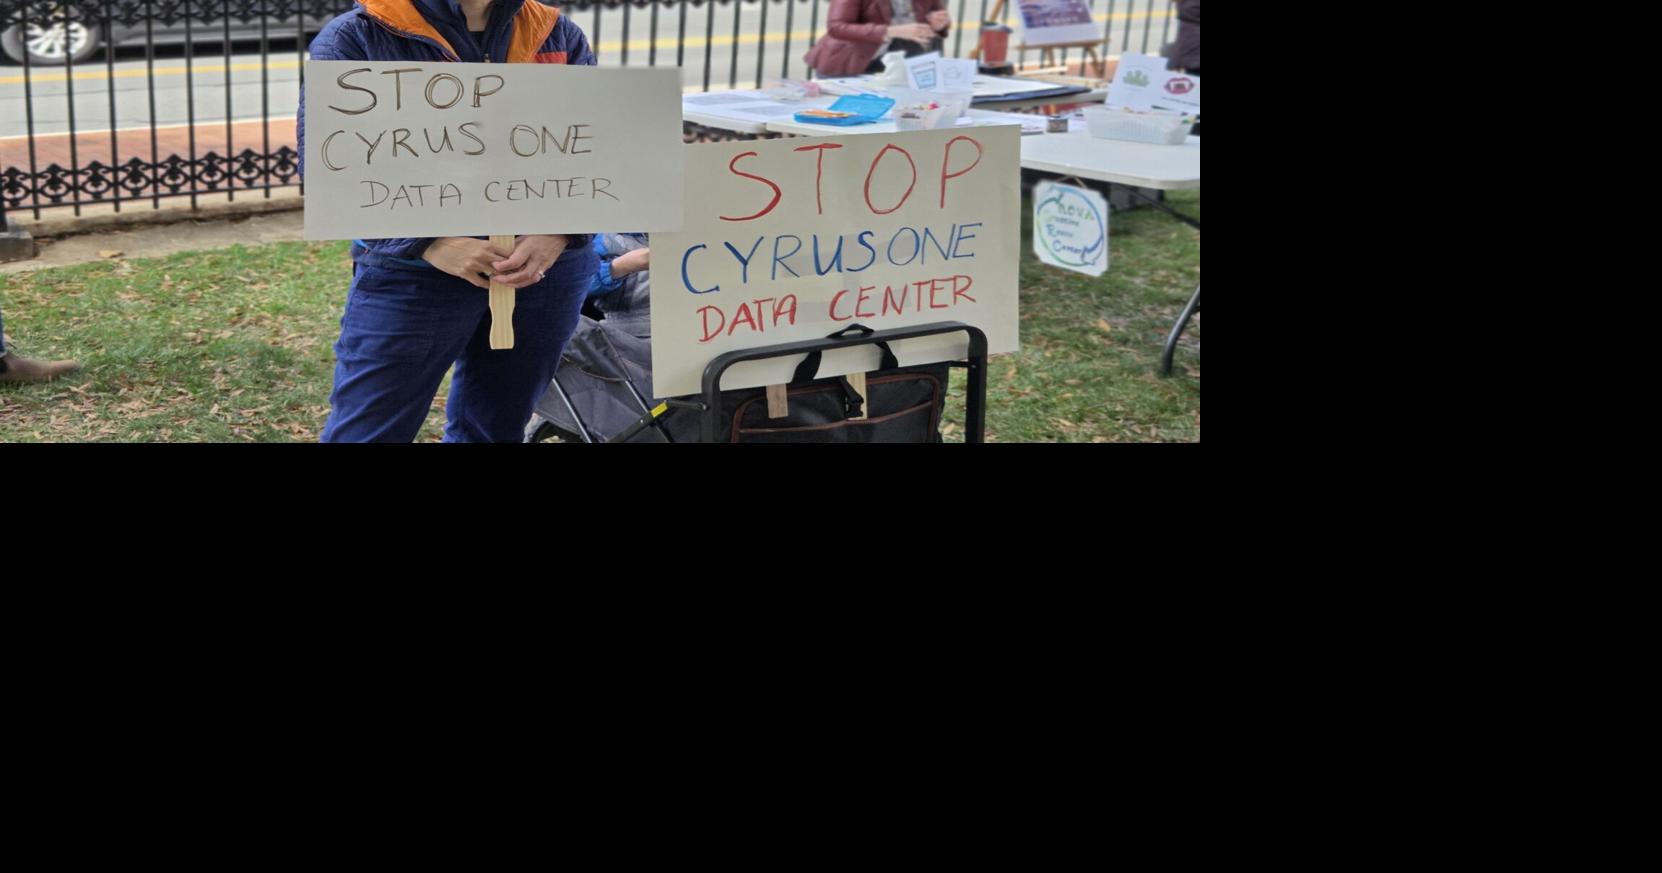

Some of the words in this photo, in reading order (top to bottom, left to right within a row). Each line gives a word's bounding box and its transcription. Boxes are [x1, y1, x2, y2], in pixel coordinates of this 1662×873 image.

[328, 68, 504, 115] STOP
[321, 122, 486, 171] CYRUS
[509, 124, 594, 157] ONE
[360, 180, 462, 210] DATA
[484, 177, 620, 202] CENTER
[719, 136, 985, 221] STOP
[697, 294, 798, 342] DATA
[828, 274, 976, 322] CENTER
